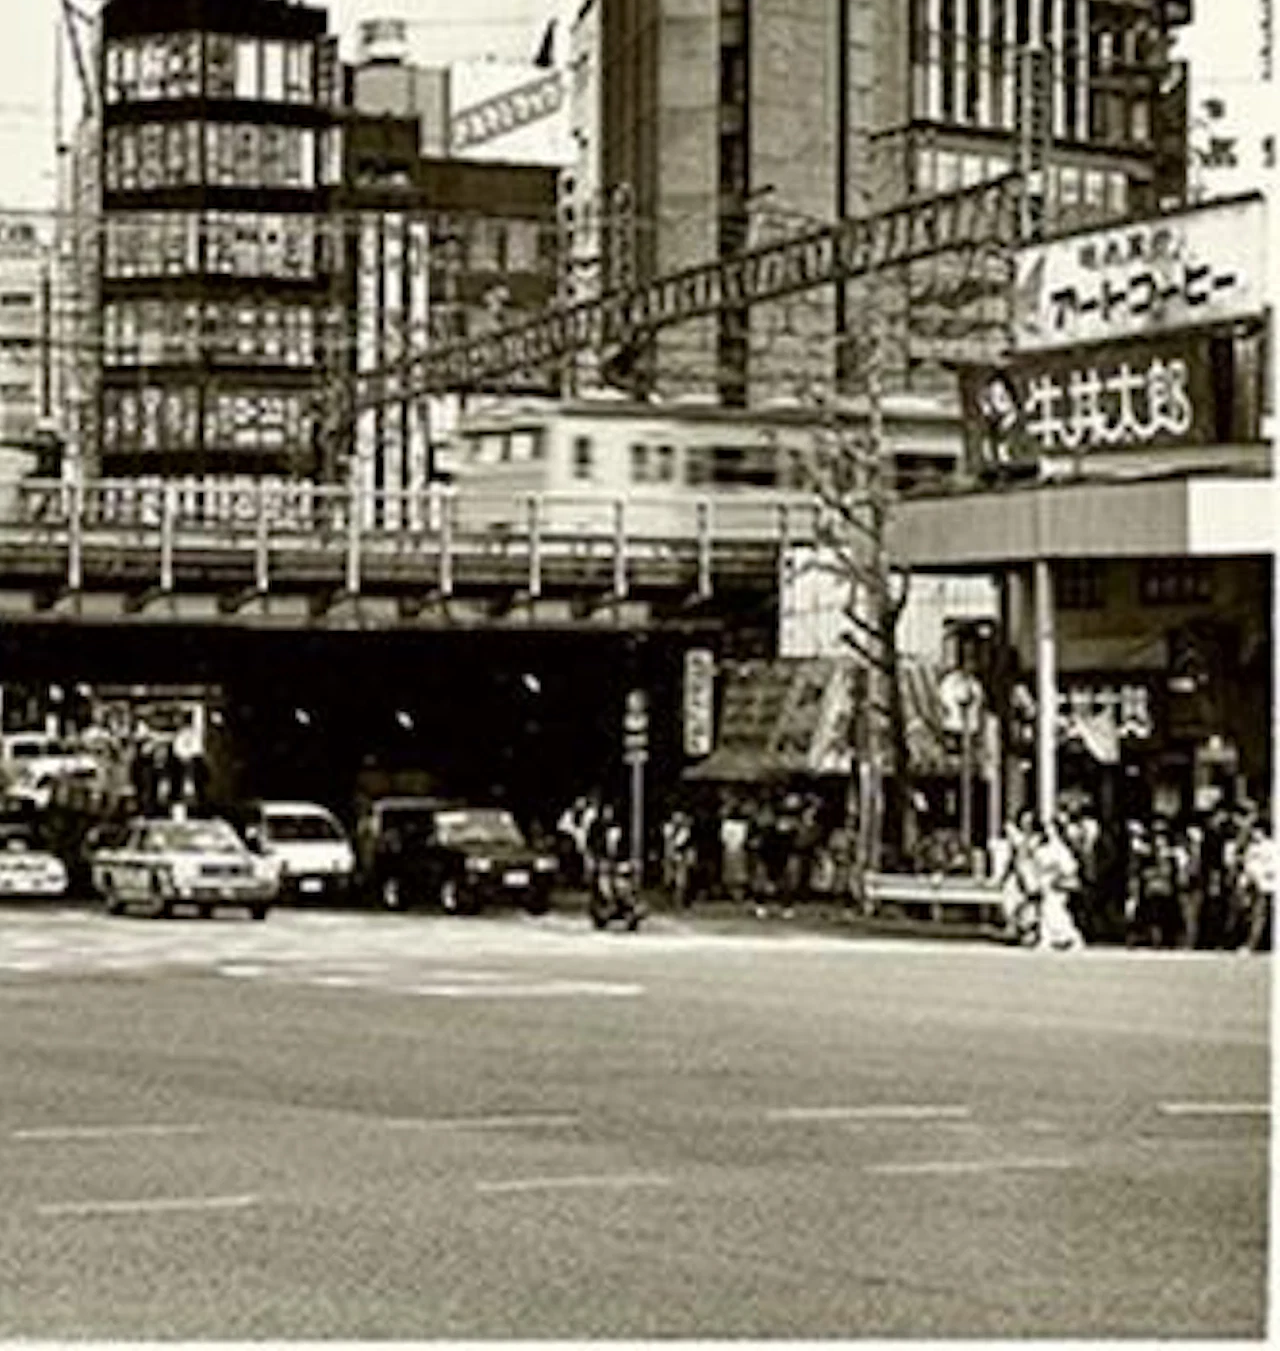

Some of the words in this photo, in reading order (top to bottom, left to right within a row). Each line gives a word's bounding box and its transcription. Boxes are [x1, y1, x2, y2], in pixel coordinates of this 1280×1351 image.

[1050, 263, 1236, 330] アートコーヒー
